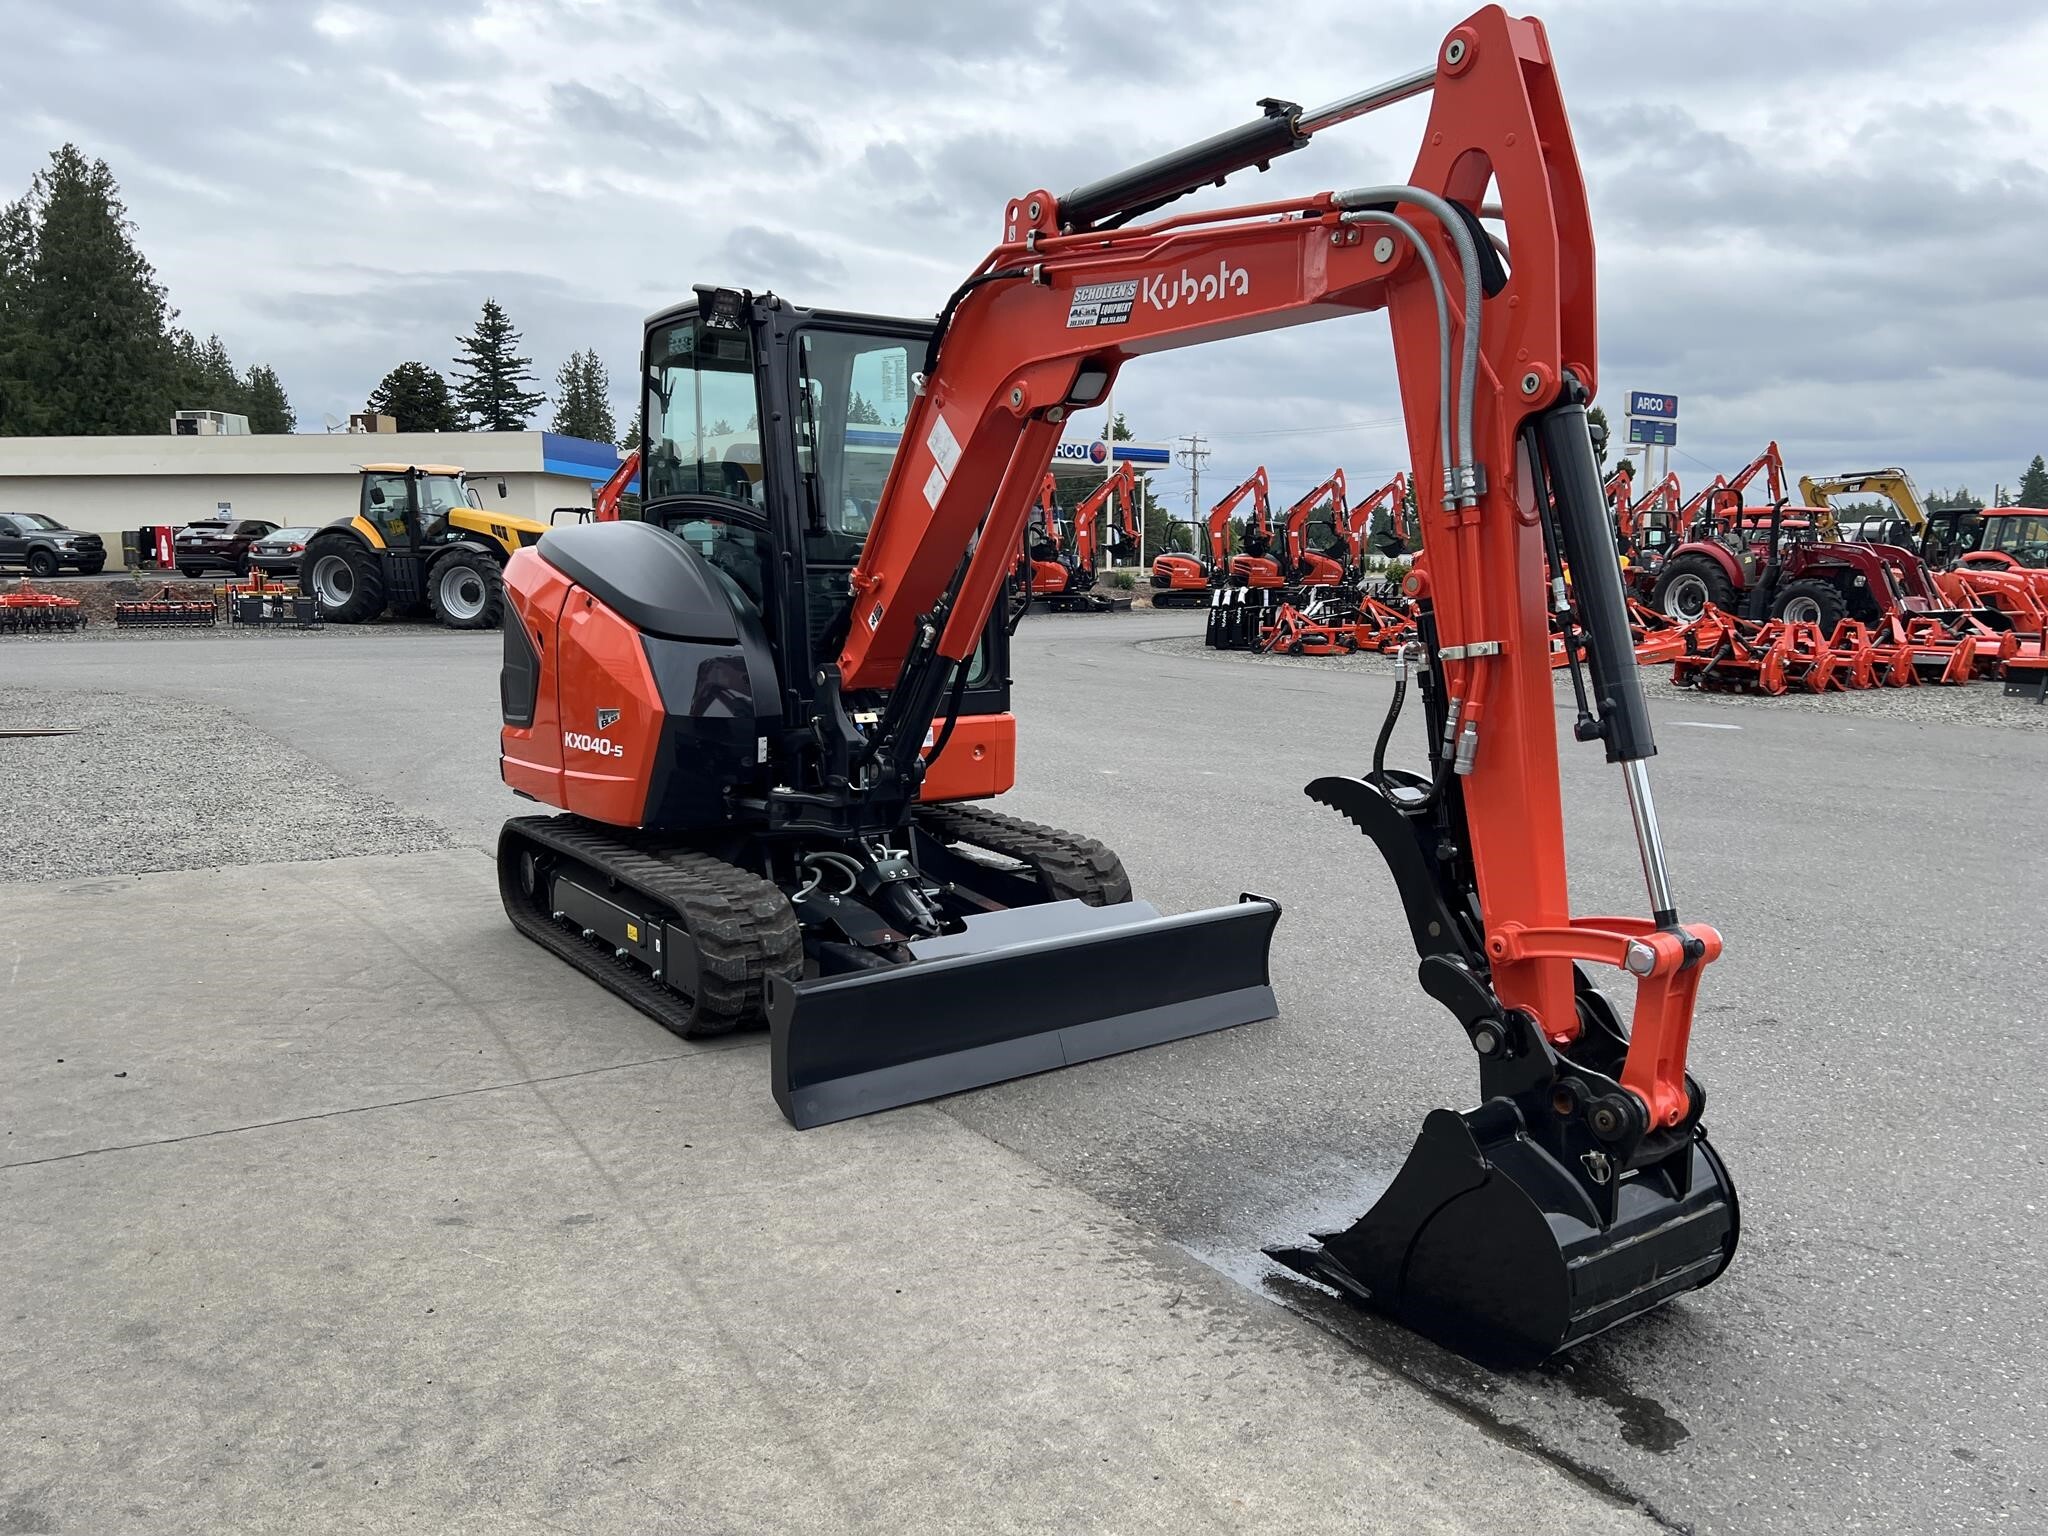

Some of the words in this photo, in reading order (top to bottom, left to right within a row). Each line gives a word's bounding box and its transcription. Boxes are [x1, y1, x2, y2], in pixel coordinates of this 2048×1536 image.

[1074, 283, 1136, 303] SCHOLTEN'S
[1143, 260, 1249, 311] Kubota
[1100, 302, 1133, 315] EQUIPMENT
[1637, 396, 1663, 412] ARCO
[1053, 444, 1084, 458] RCO
[564, 731, 624, 758] KX040-5
